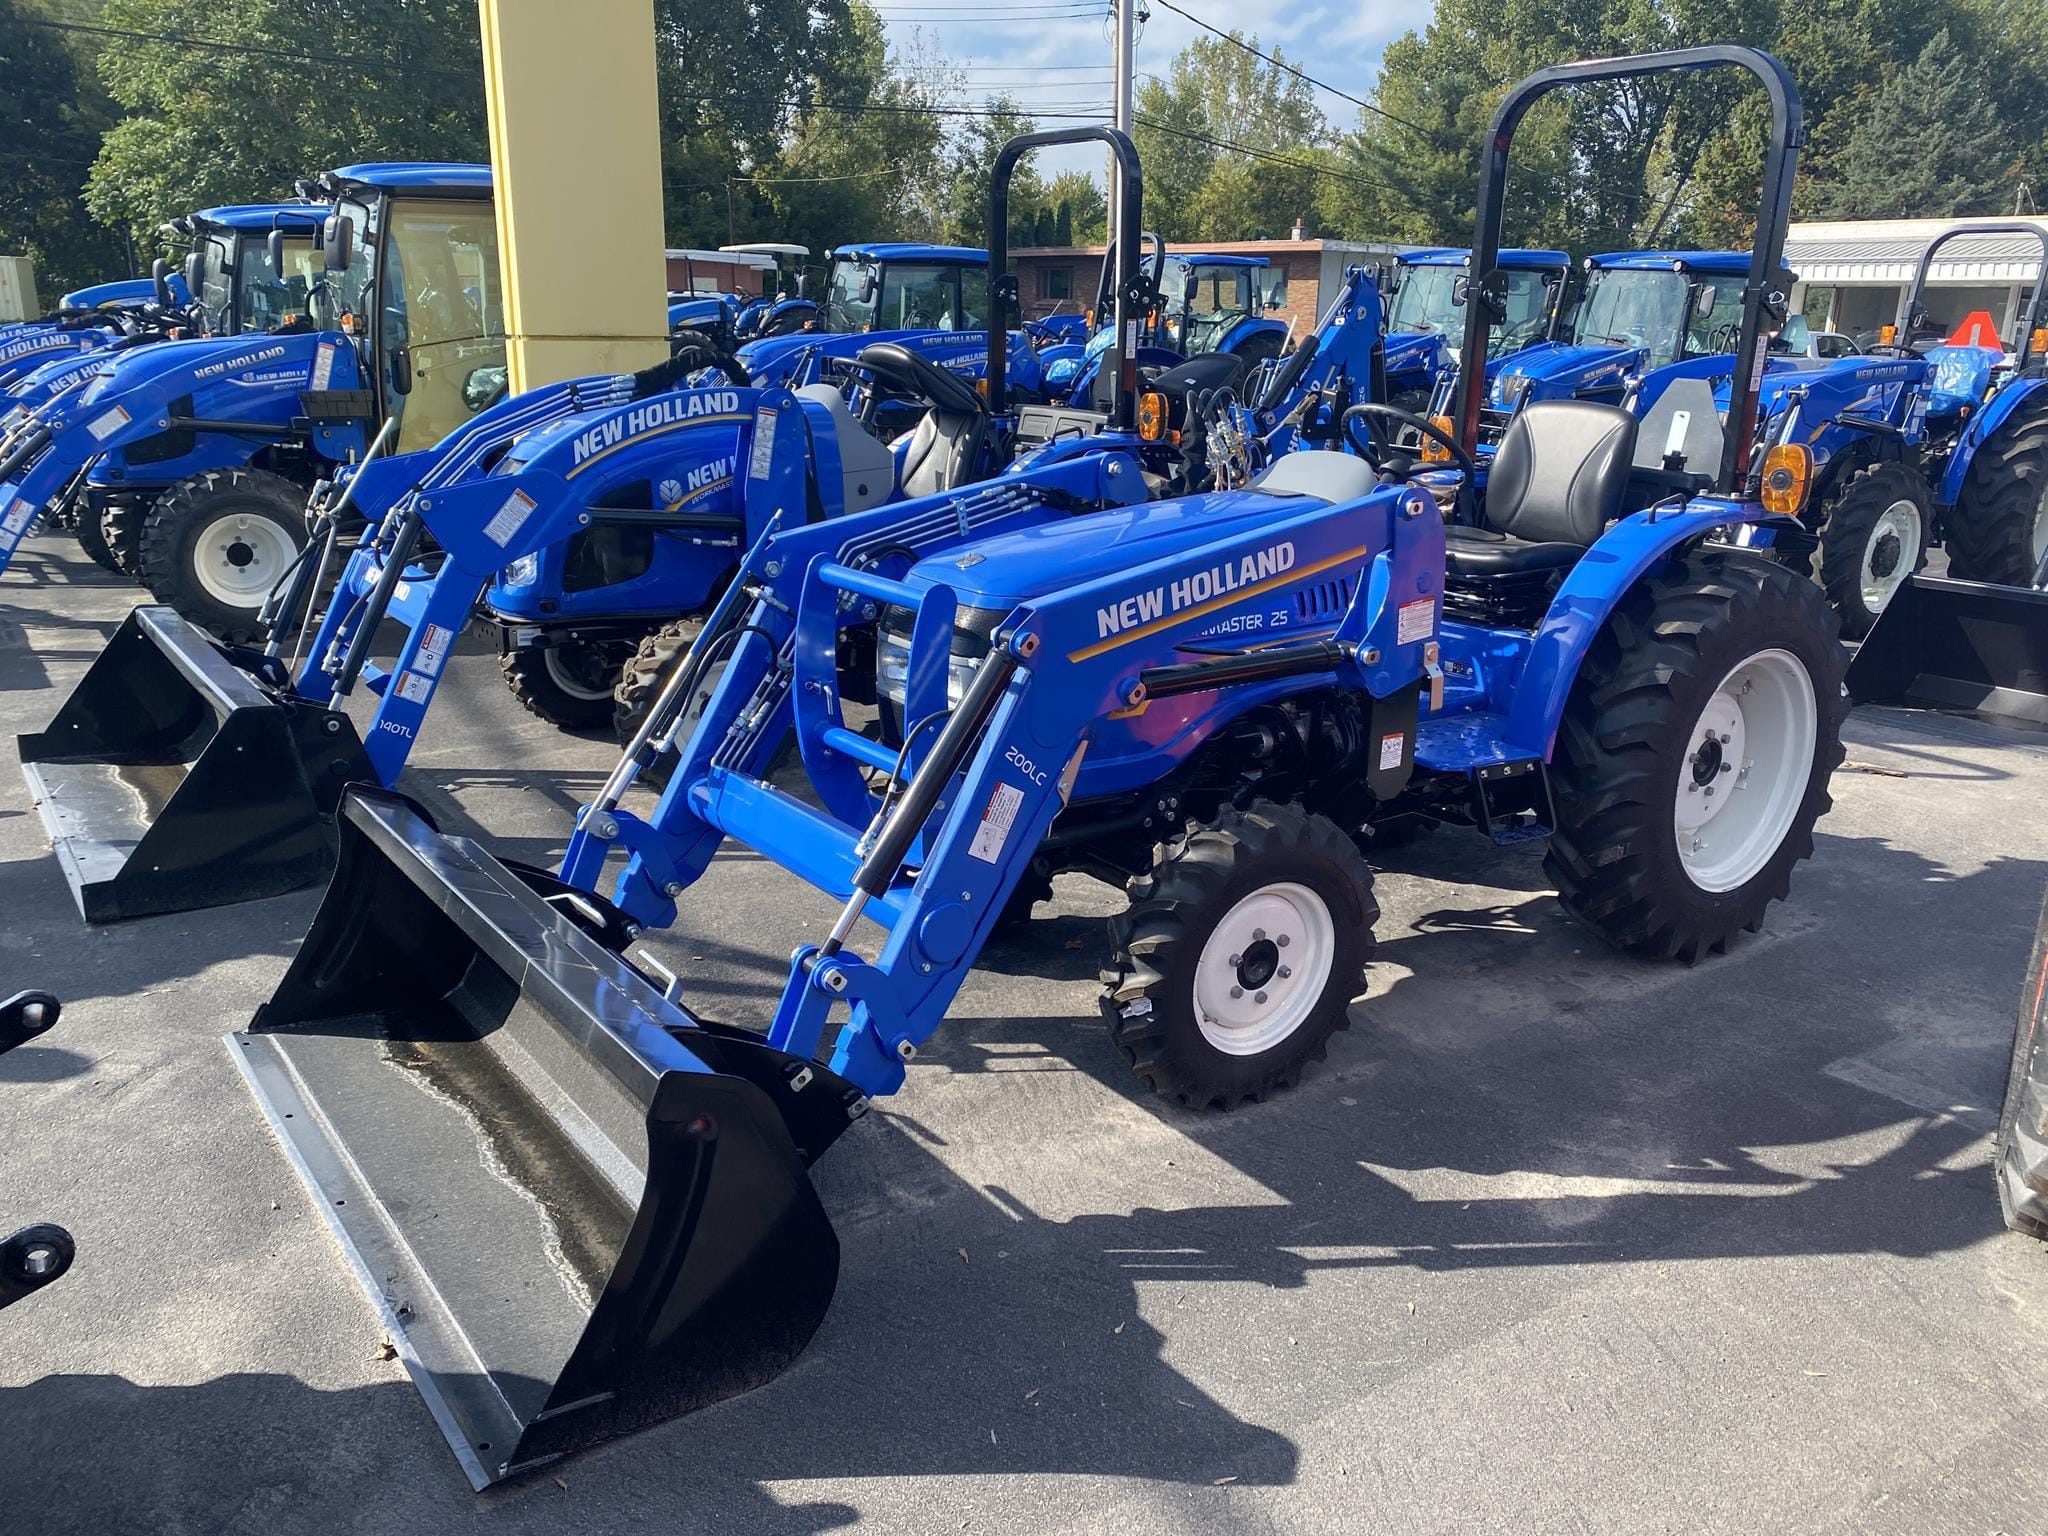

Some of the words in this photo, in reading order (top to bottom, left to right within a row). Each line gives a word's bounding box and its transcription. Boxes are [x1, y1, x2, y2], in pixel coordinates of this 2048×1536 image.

[7, 334, 70, 358] HOLLAND
[922, 337, 943, 346] NEW
[944, 334, 983, 345] HOLLAND
[193, 363, 225, 379] NEW
[226, 346, 285, 369] HOLLAND
[1856, 368, 1873, 380] NEW
[1874, 365, 1908, 378] HOLLAND
[47, 371, 80, 394] NEW
[256, 372, 277, 381] NEW
[572, 415, 623, 465] NEW
[628, 391, 739, 435] HOLLAND
[687, 458, 727, 491] NEW
[1097, 586, 1164, 639] NEW
[1170, 541, 1295, 611] HOLLAND
[1270, 610, 1289, 627] 25
[1004, 745, 1048, 787] 200LC
